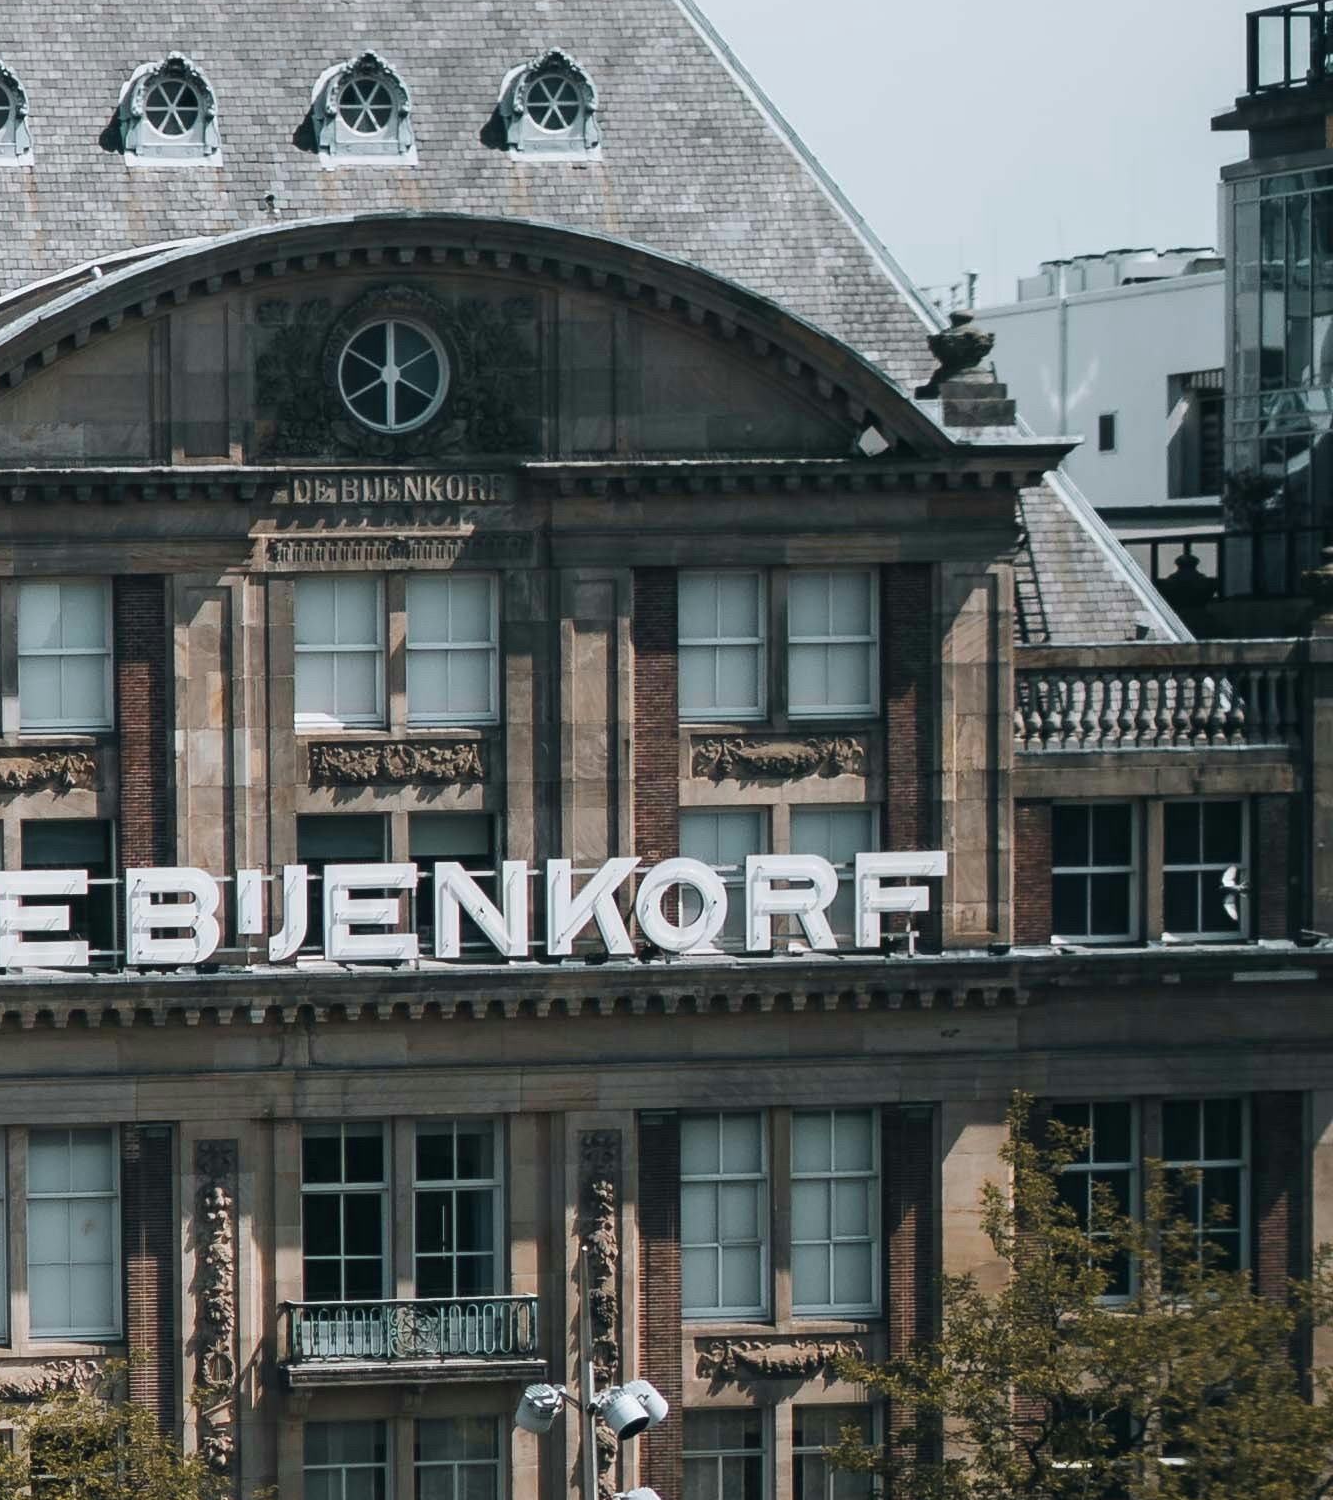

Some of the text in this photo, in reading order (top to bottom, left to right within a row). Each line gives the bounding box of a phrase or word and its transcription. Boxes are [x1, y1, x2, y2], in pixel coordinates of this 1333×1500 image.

[293, 473, 505, 504] DE BIJENKORF
[124, 850, 950, 965] BIJENKORF
